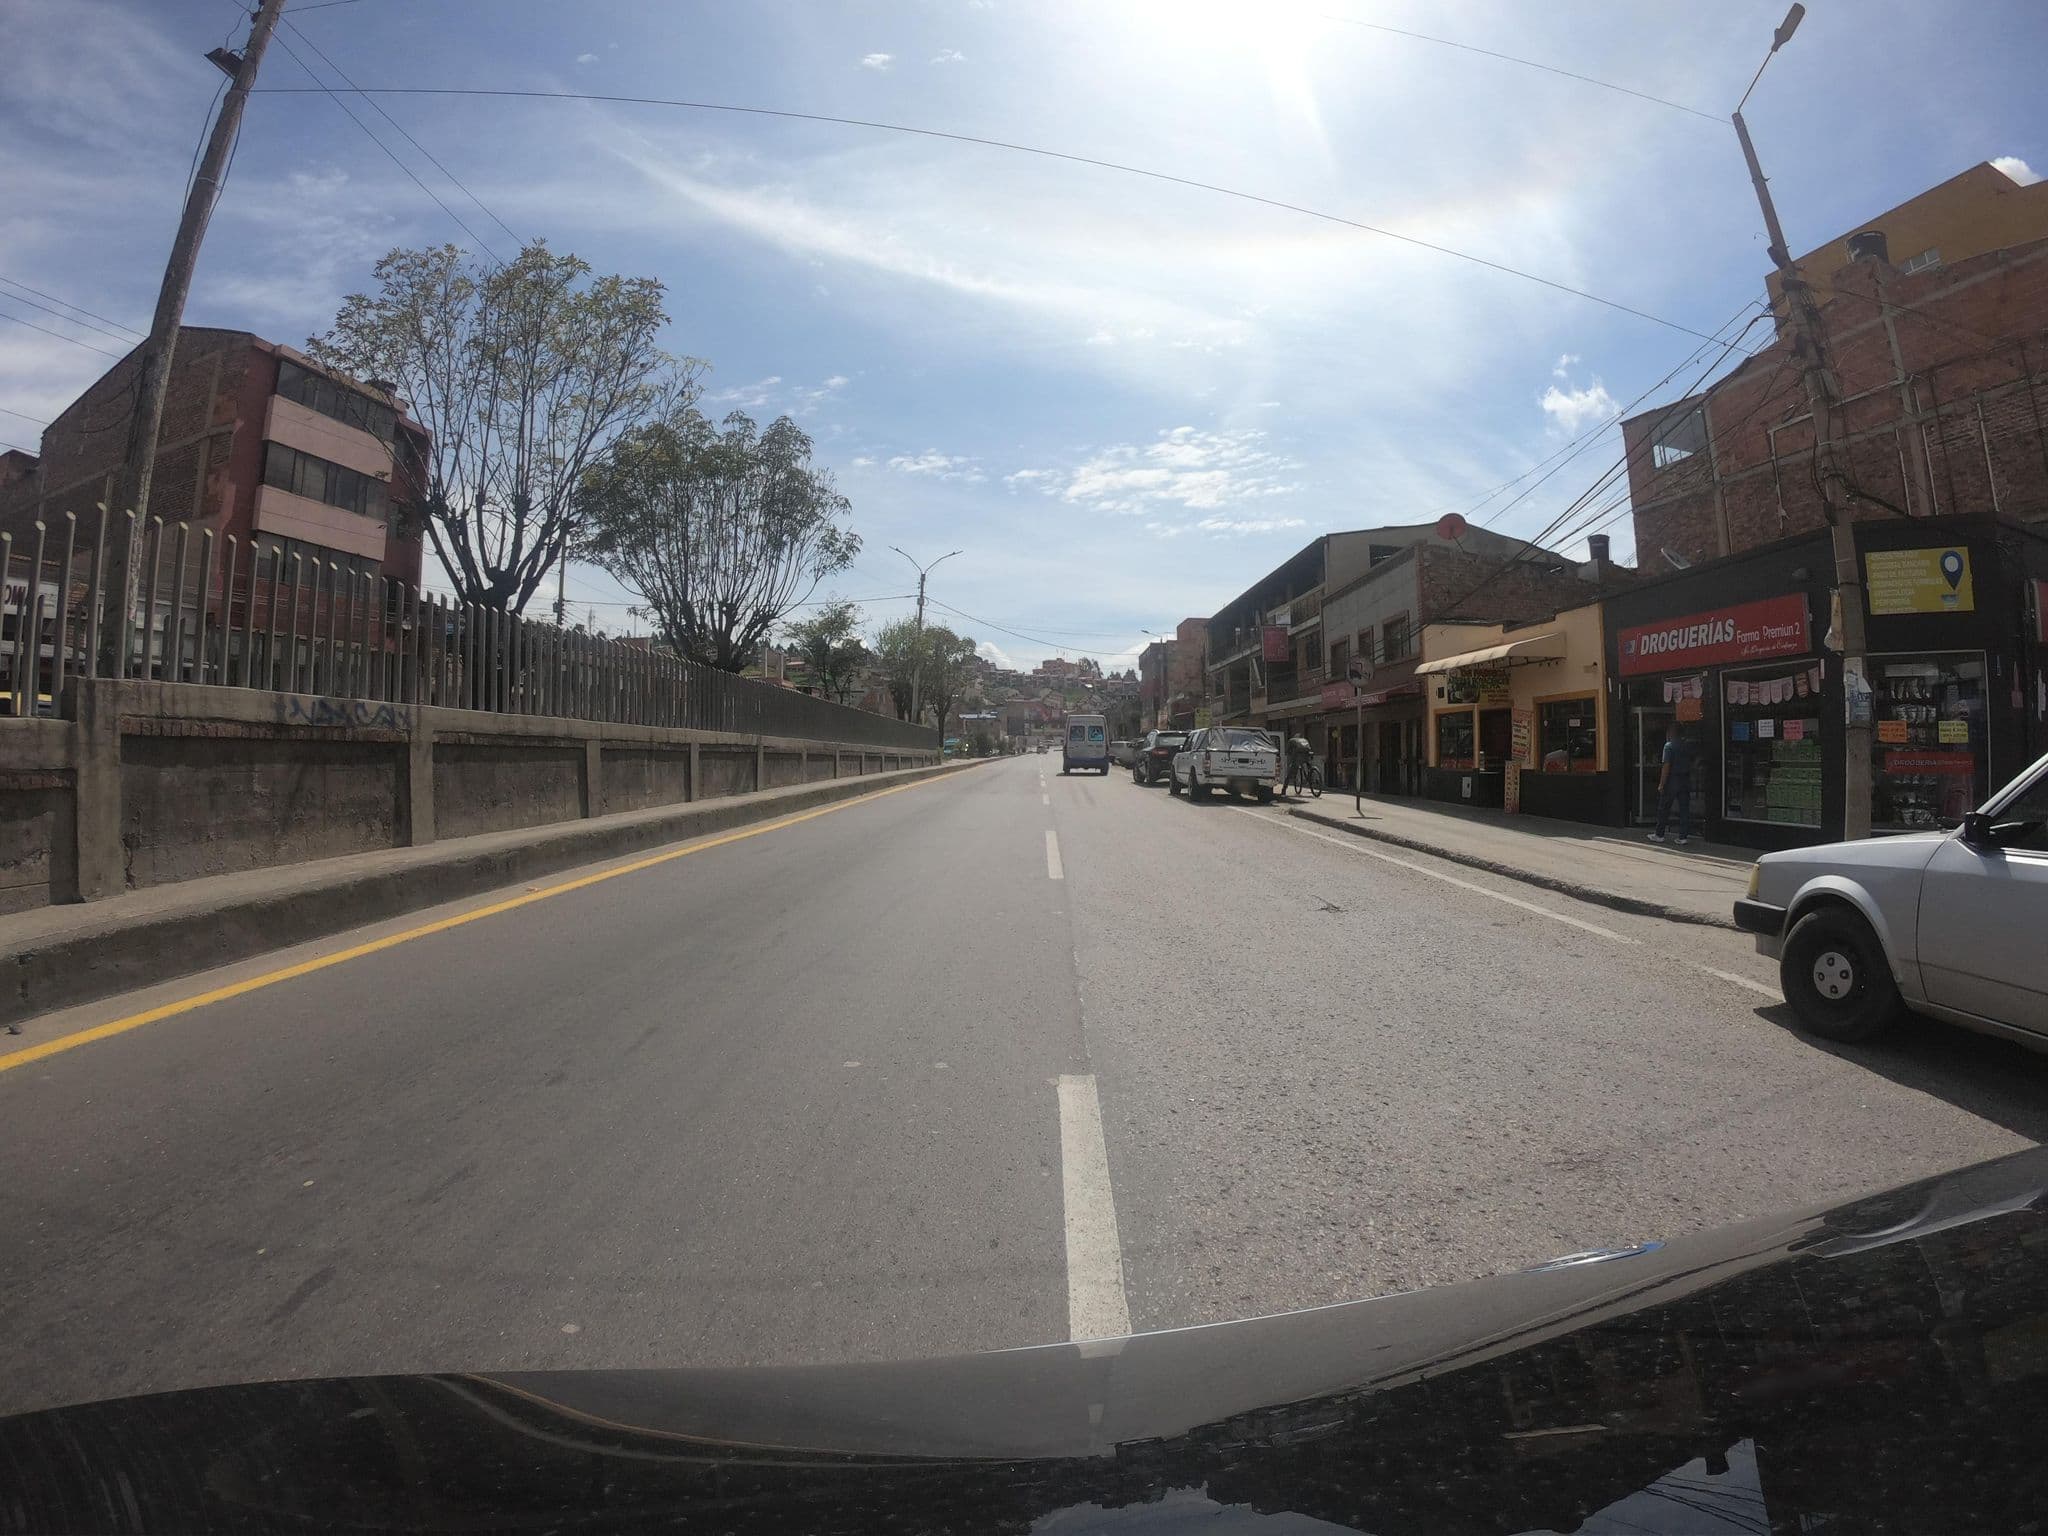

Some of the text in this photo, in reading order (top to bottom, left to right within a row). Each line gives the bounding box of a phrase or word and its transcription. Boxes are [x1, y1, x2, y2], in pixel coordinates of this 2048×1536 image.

[1640, 617, 1735, 655] DROGUERÍAS
[1736, 630, 1760, 644] Farma
[1795, 622, 1801, 635] 2
